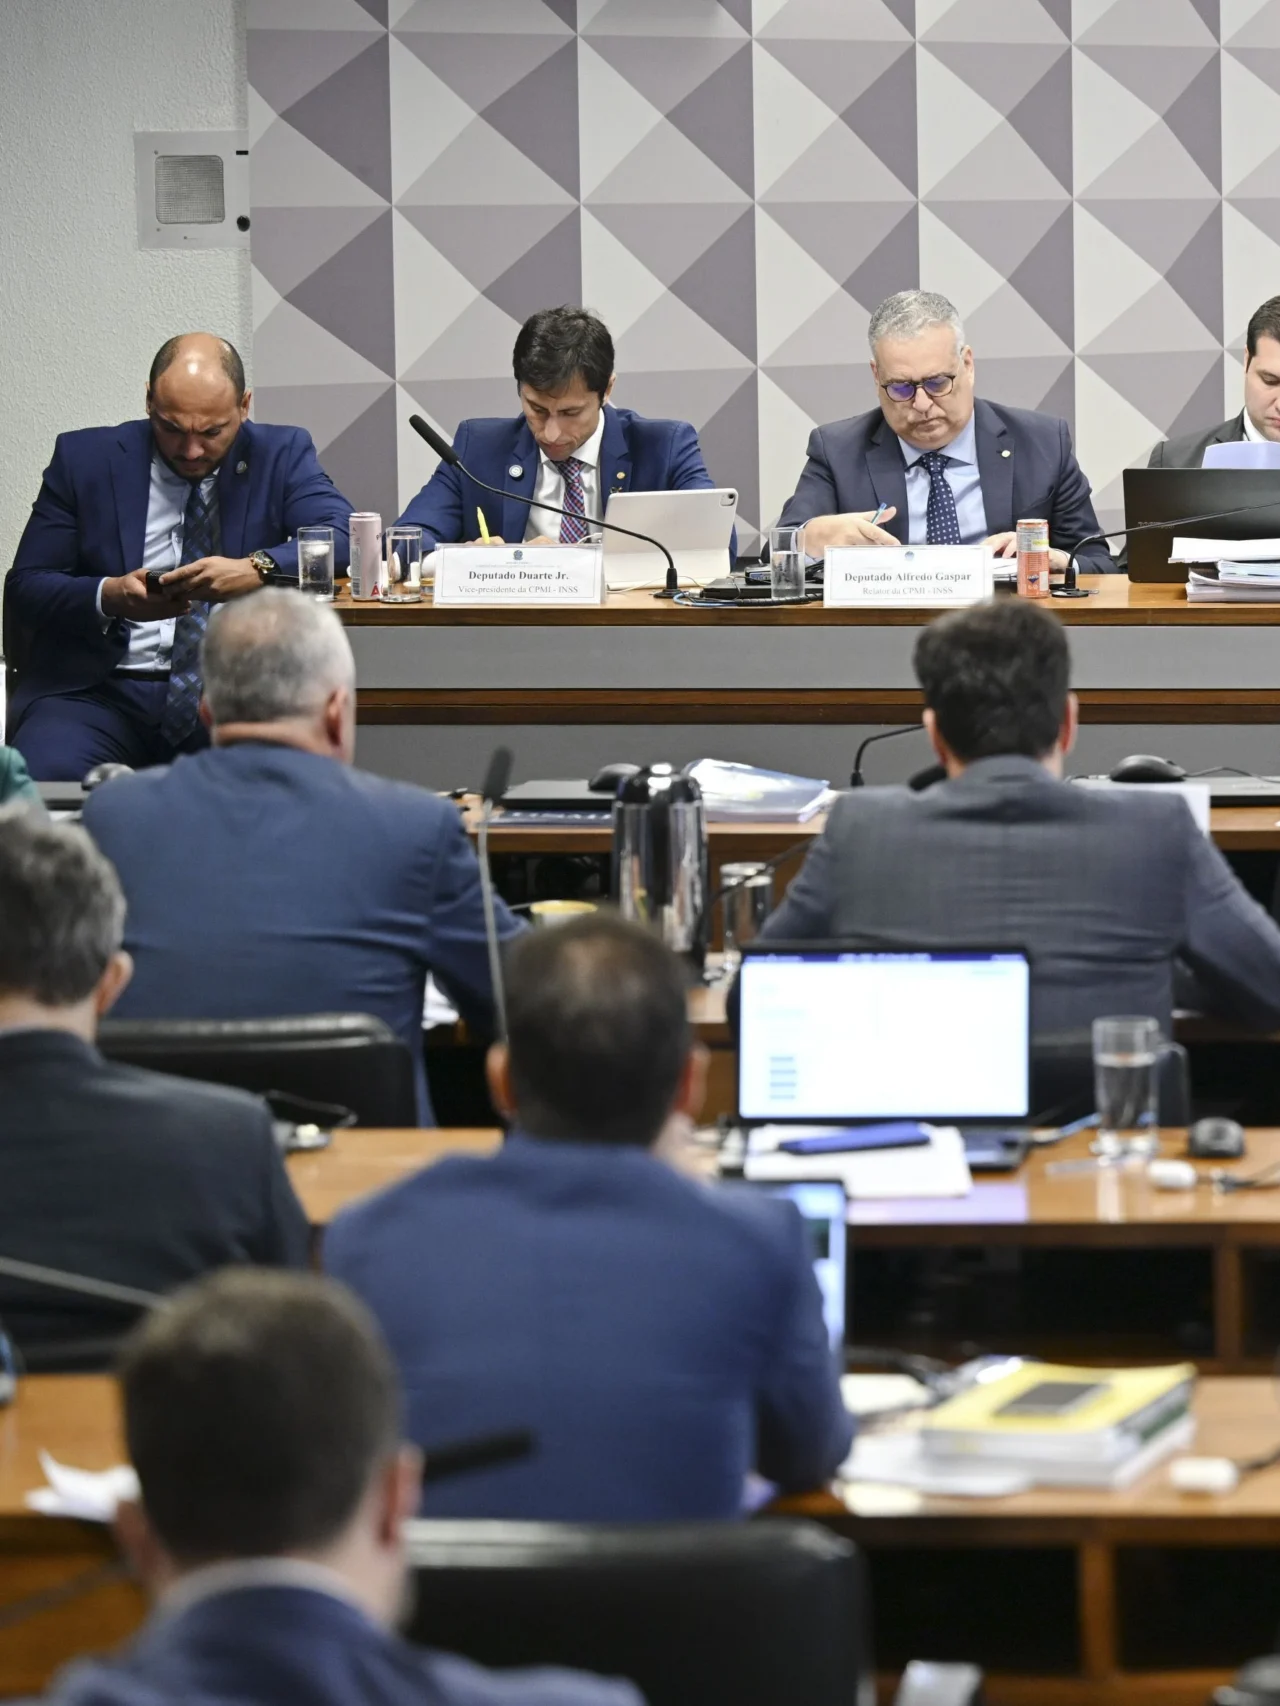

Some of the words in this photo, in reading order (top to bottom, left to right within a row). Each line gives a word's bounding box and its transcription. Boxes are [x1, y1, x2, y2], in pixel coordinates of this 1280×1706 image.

[468, 571, 516, 581] Deputado
[519, 571, 553, 580] Duarte
[555, 571, 569, 580] Jr.
[844, 573, 892, 583] Deputado
[895, 573, 932, 582] Alfredo
[935, 573, 972, 583] Gaspar
[458, 585, 516, 594] Vice-presidente
[862, 587, 890, 595] Relator
[892, 587, 901, 595] da
[902, 587, 926, 595] CPMI
[933, 587, 954, 595] INSS
